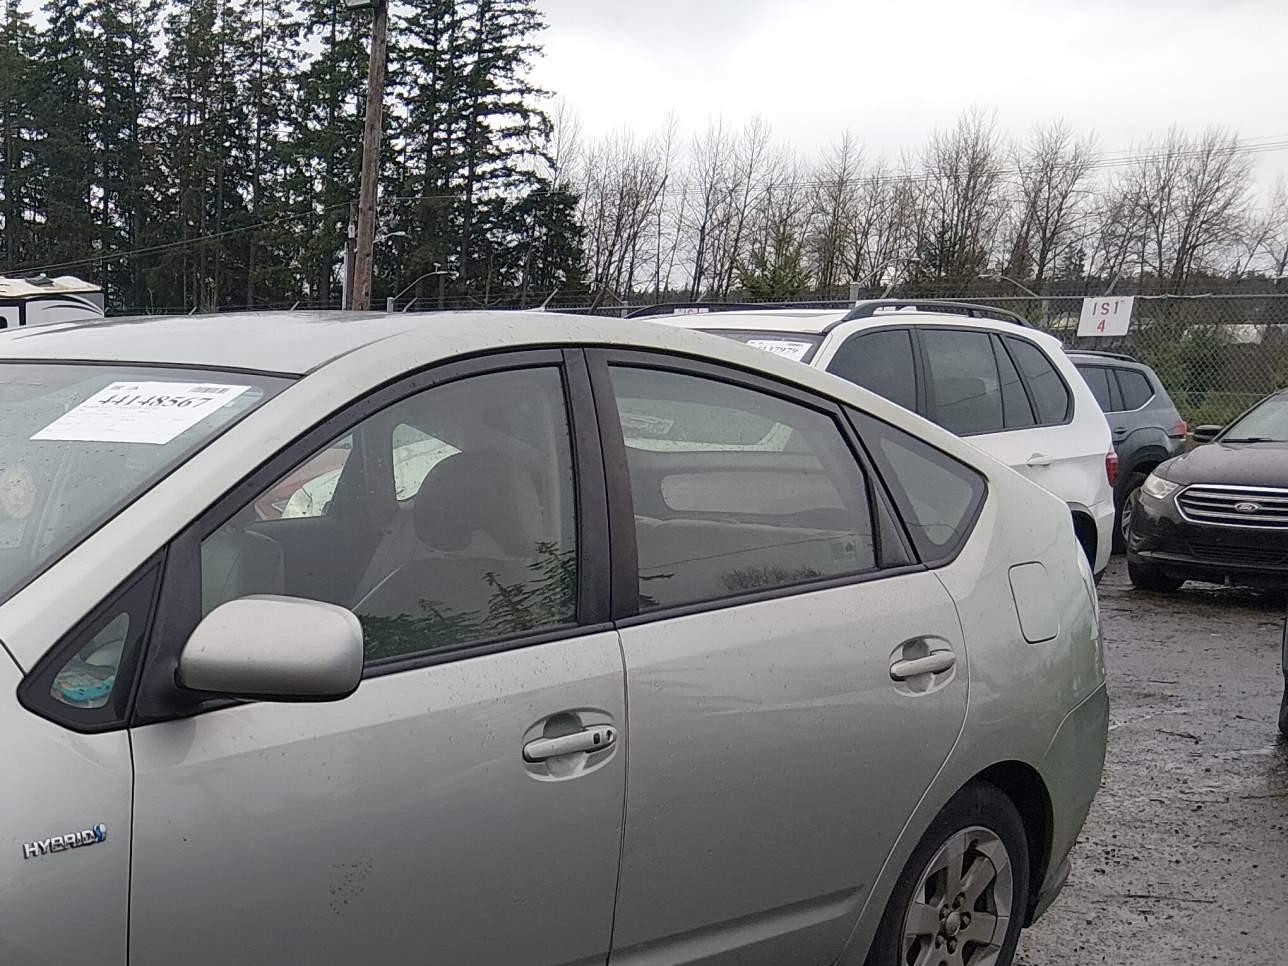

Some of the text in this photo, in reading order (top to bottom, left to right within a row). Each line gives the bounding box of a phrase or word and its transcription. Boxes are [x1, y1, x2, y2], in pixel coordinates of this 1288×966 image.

[1096, 319, 1107, 333] 4
[98, 393, 213, 409] 44148567
[23, 829, 94, 859] HYBRID
